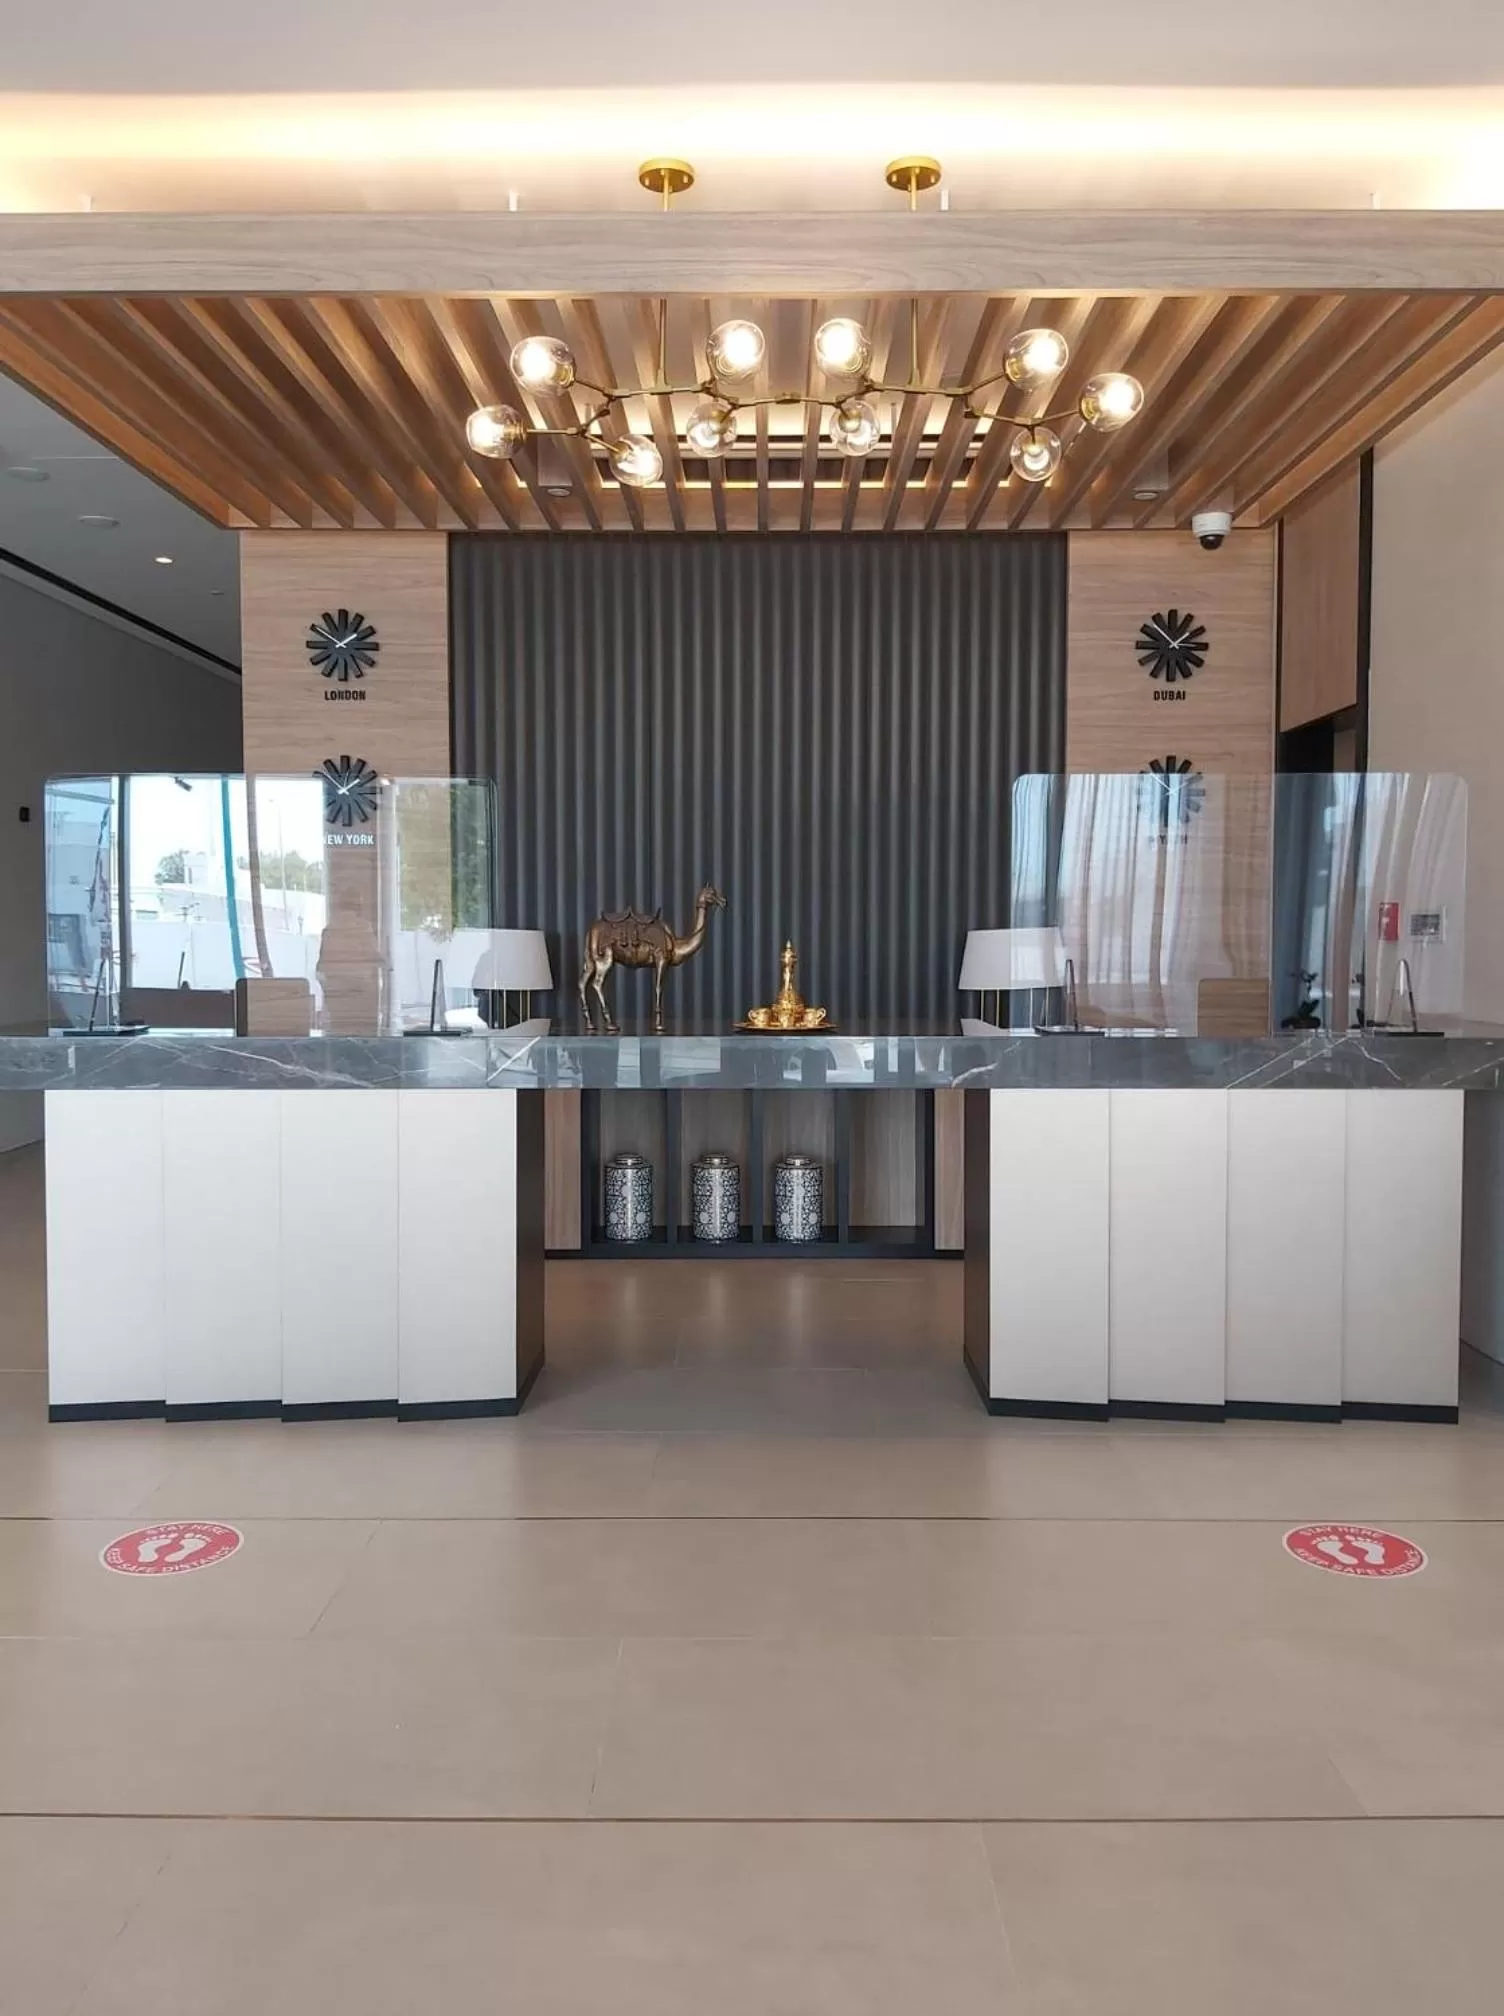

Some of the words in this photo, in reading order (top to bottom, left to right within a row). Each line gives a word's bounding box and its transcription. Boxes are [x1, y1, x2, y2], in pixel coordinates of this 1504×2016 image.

[324, 690, 366, 701] LONDON
[1153, 690, 1186, 701] DUBAI
[322, 834, 344, 845] EW
[346, 834, 375, 845] YORK
